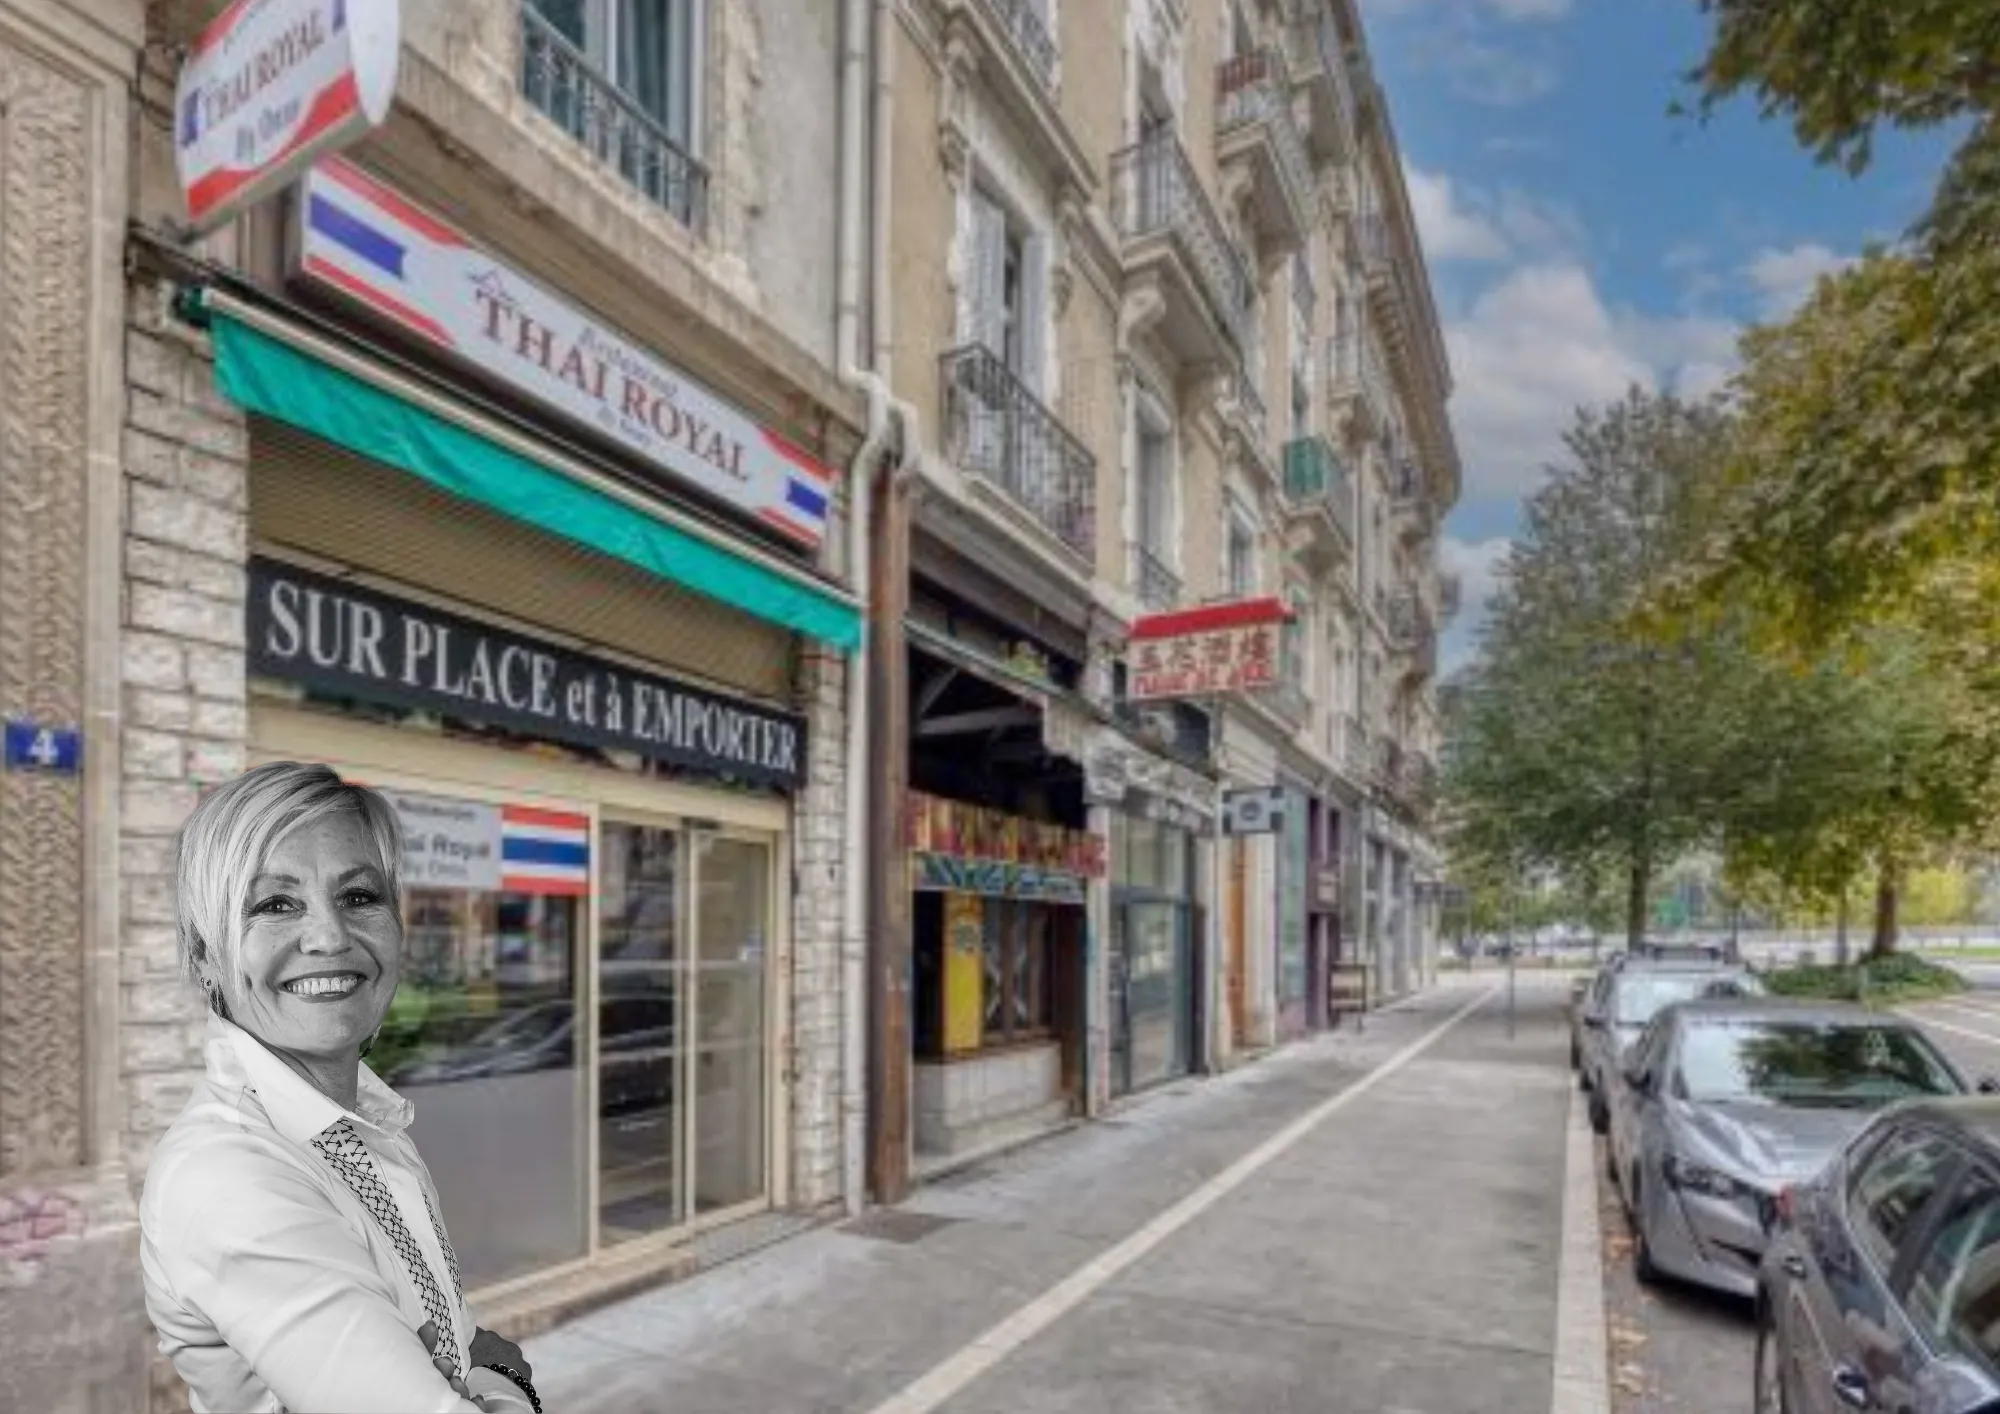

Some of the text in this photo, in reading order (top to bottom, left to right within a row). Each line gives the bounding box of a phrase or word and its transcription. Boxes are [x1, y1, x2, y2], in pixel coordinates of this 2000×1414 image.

[483, 296, 606, 401] THAI
[618, 374, 749, 482] ROYAL
[28, 727, 59, 765] 4
[267, 579, 796, 774] SUR PLACE et à EMPORTER
